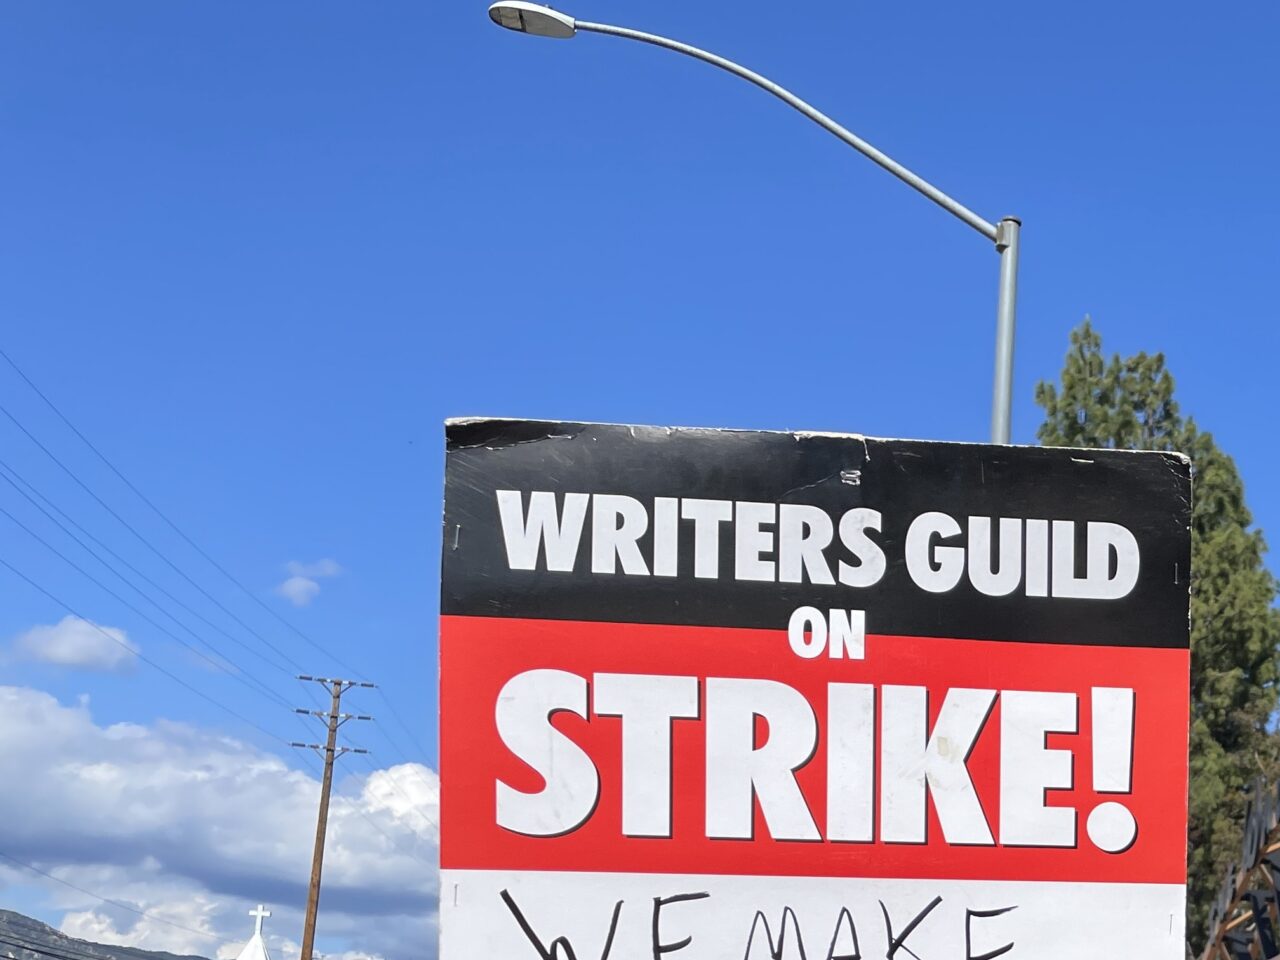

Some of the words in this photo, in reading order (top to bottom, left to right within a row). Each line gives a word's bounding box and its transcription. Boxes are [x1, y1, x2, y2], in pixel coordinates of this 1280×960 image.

[495, 489, 887, 588] WRITERS
[904, 511, 1140, 600] GUILD
[787, 606, 866, 660] ON
[494, 668, 1139, 854] STRIKE!
